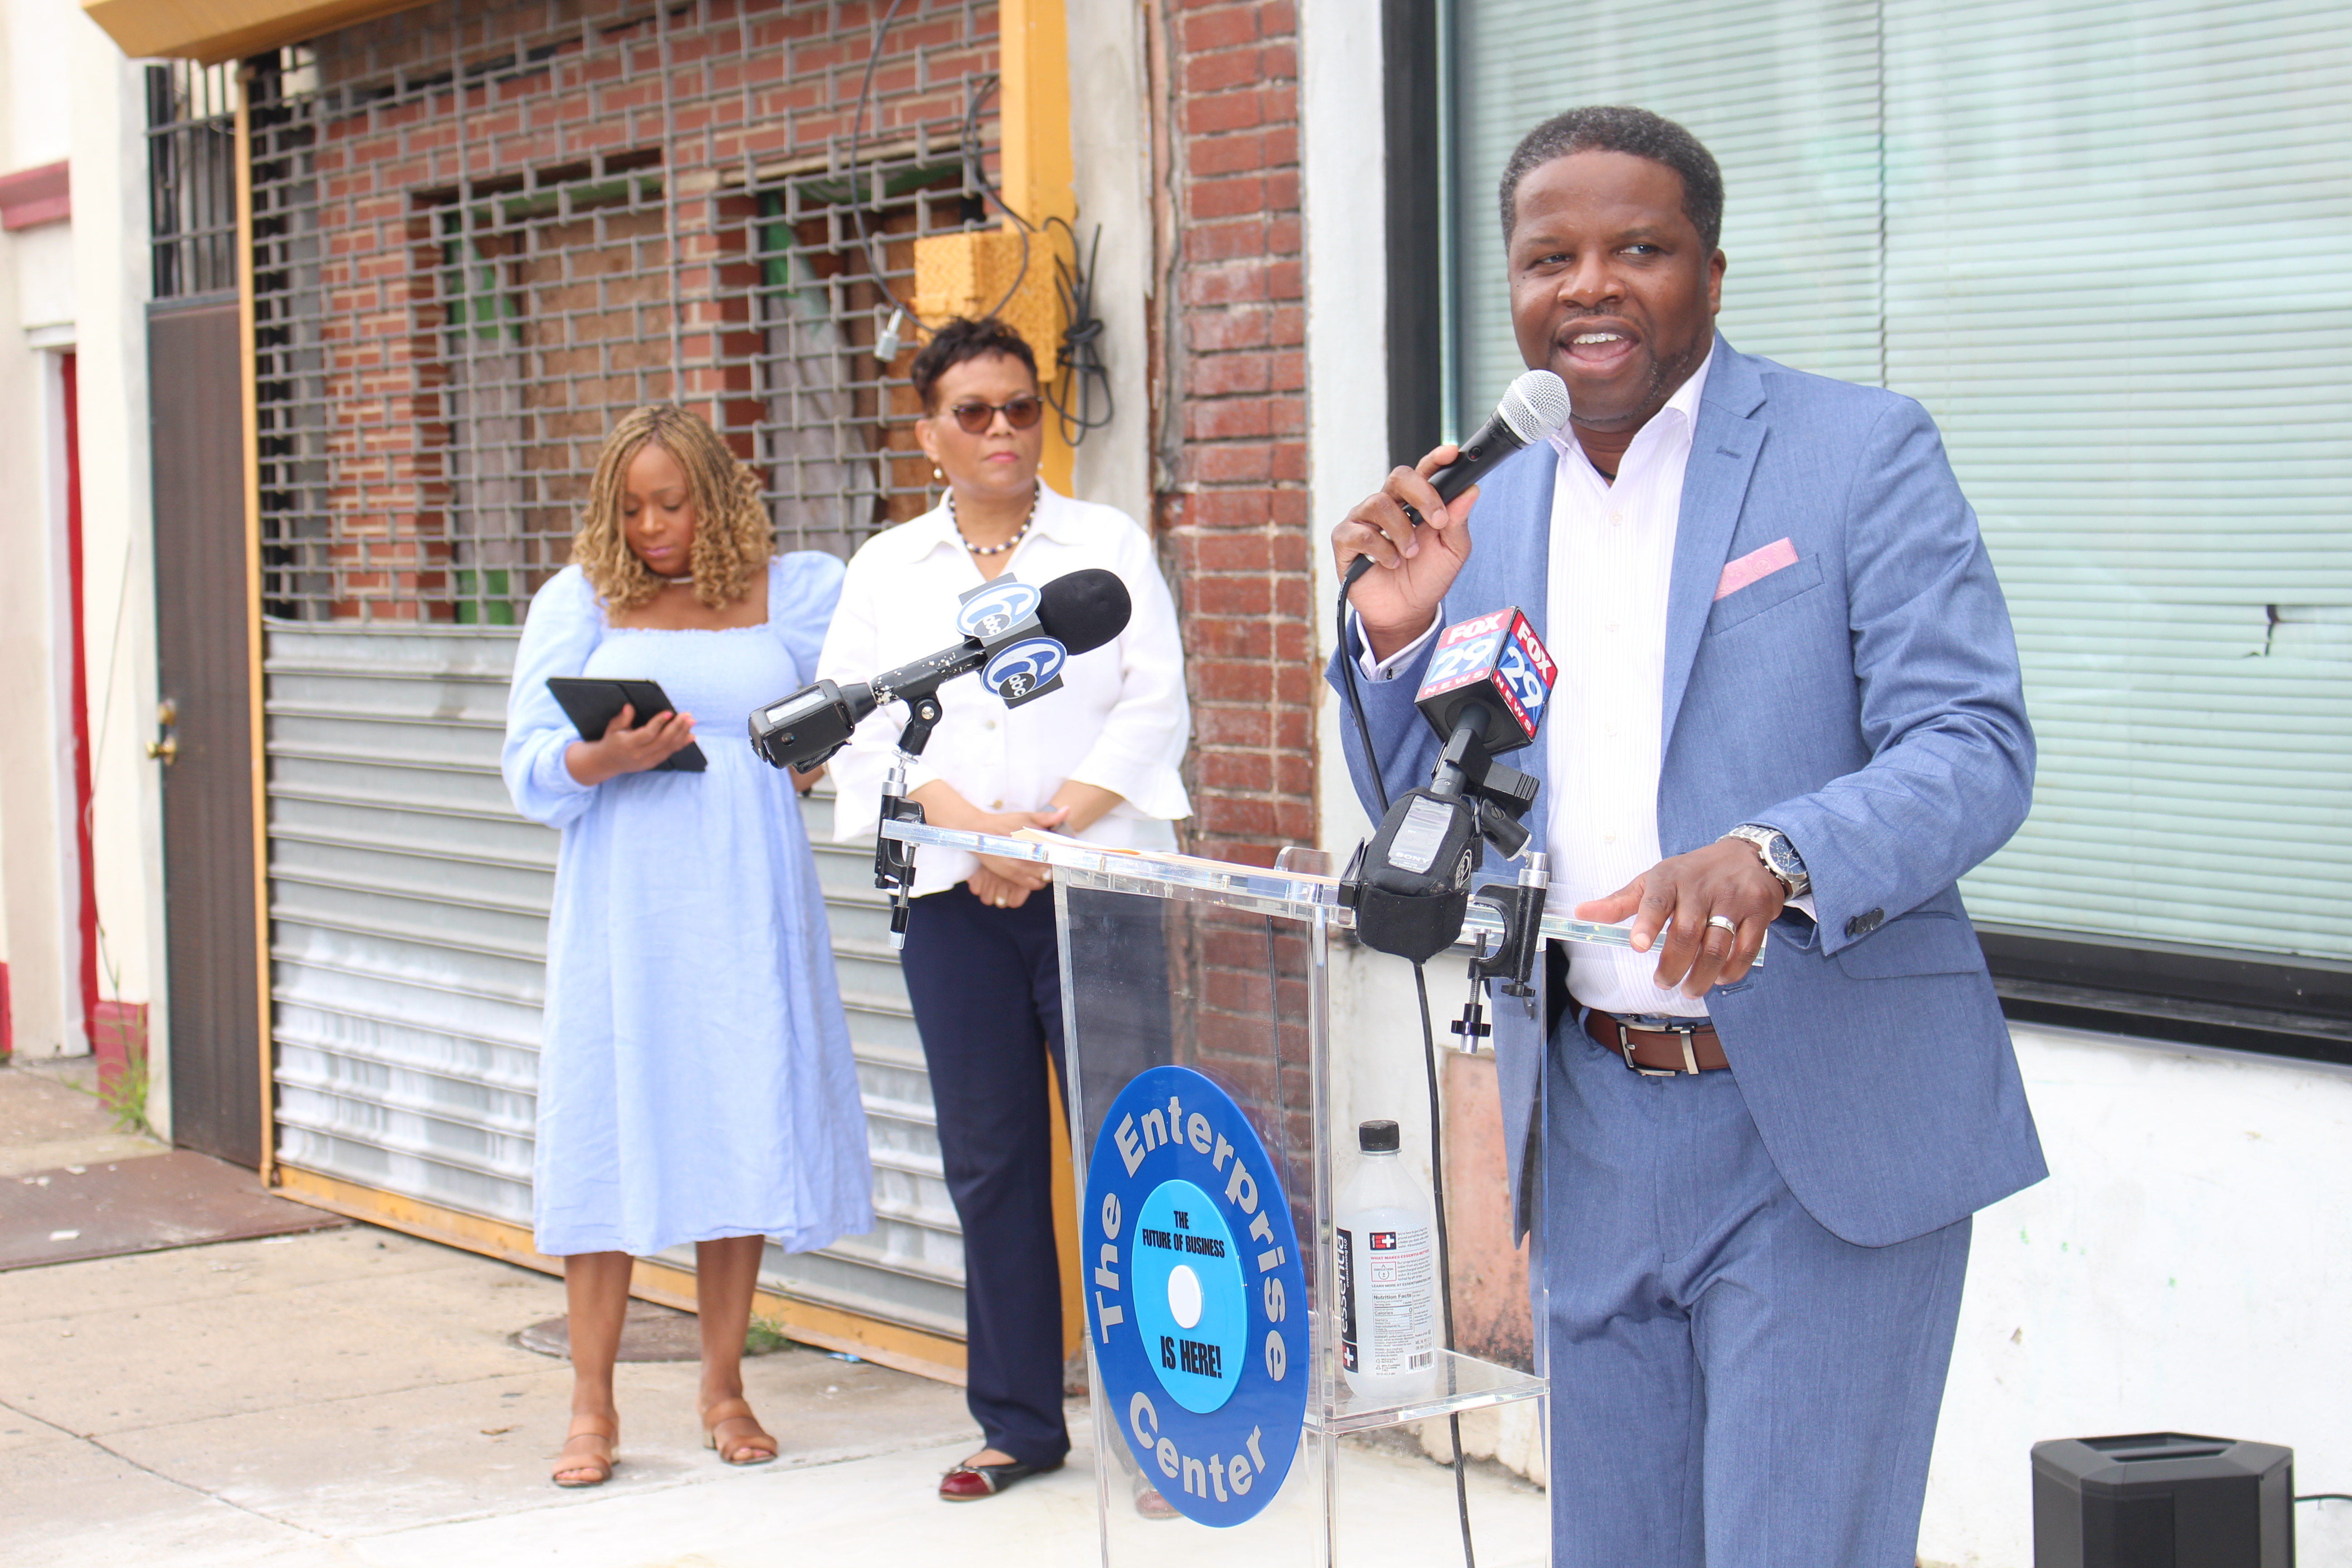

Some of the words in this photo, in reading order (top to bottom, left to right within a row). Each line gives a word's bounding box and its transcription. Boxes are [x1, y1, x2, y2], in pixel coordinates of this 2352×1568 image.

[982, 615, 1001, 635] abc
[1447, 613, 1504, 645] FOX
[1428, 638, 1496, 684] 29
[1516, 620, 1552, 681] FOX
[1008, 674, 1027, 697] abc
[1424, 670, 1484, 695] NEWS
[1499, 646, 1543, 709] 29
[1495, 675, 1532, 732] NEWS
[1396, 852, 1431, 863] SONY
[1095, 1192, 1124, 1344] The
[1113, 1096, 1286, 1382] Enterprise
[1173, 1210, 1190, 1230] THE
[1142, 1228, 1172, 1250] FUTURE
[1174, 1235, 1183, 1251] OF
[1185, 1236, 1225, 1258] BUSINESS
[1160, 1335, 1176, 1370] IS
[1179, 1339, 1222, 1379] HERE!
[1129, 1392, 1266, 1502] Center
